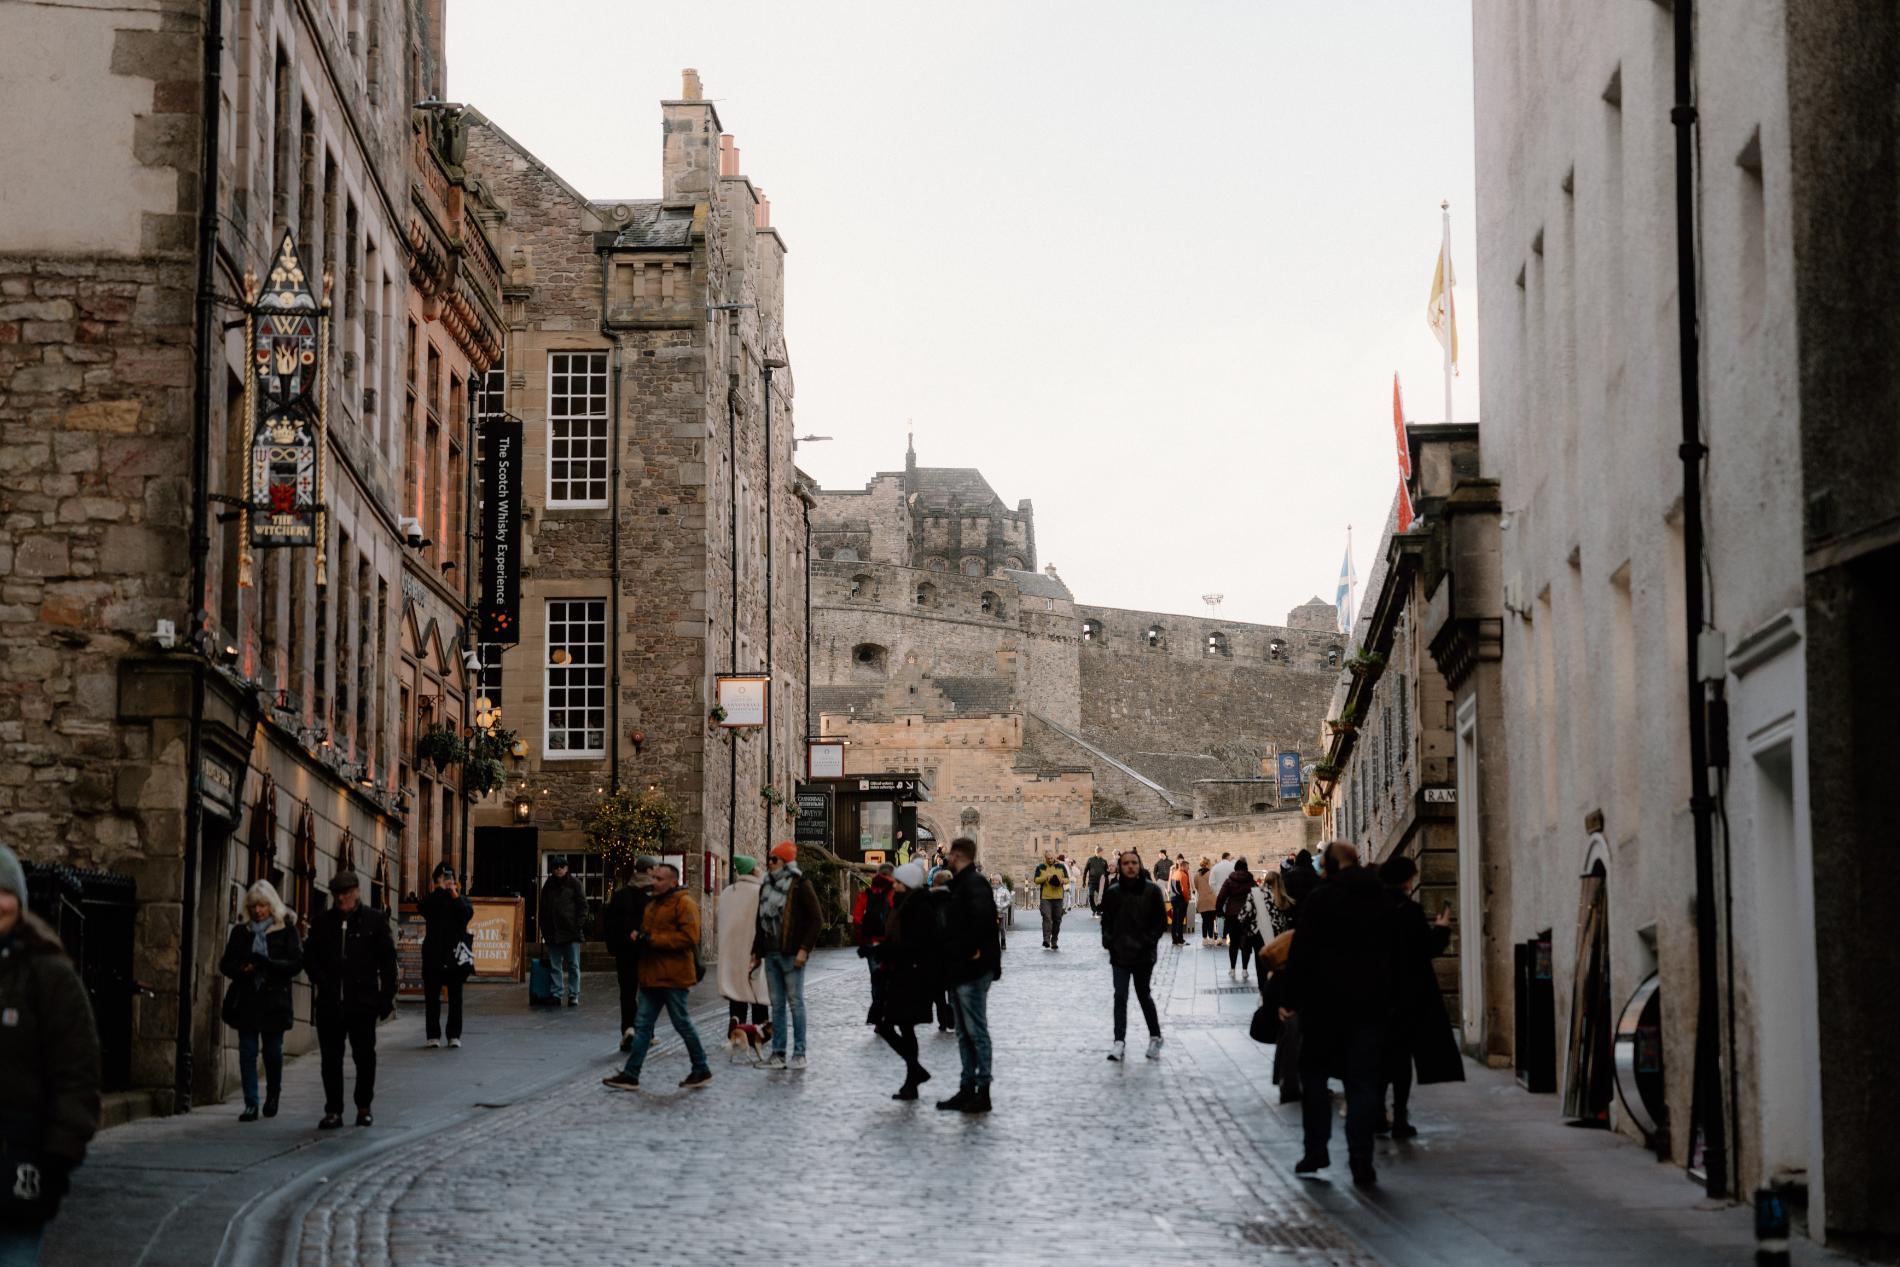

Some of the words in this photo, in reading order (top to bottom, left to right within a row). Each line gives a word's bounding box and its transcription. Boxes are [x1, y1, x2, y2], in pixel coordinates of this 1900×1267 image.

[498, 437, 510, 458] The
[498, 460, 510, 498] Scotch
[254, 525, 310, 537] WITCHERY
[272, 515, 293, 525] THE
[495, 500, 509, 542] Whisky
[496, 544, 508, 605] Experience
